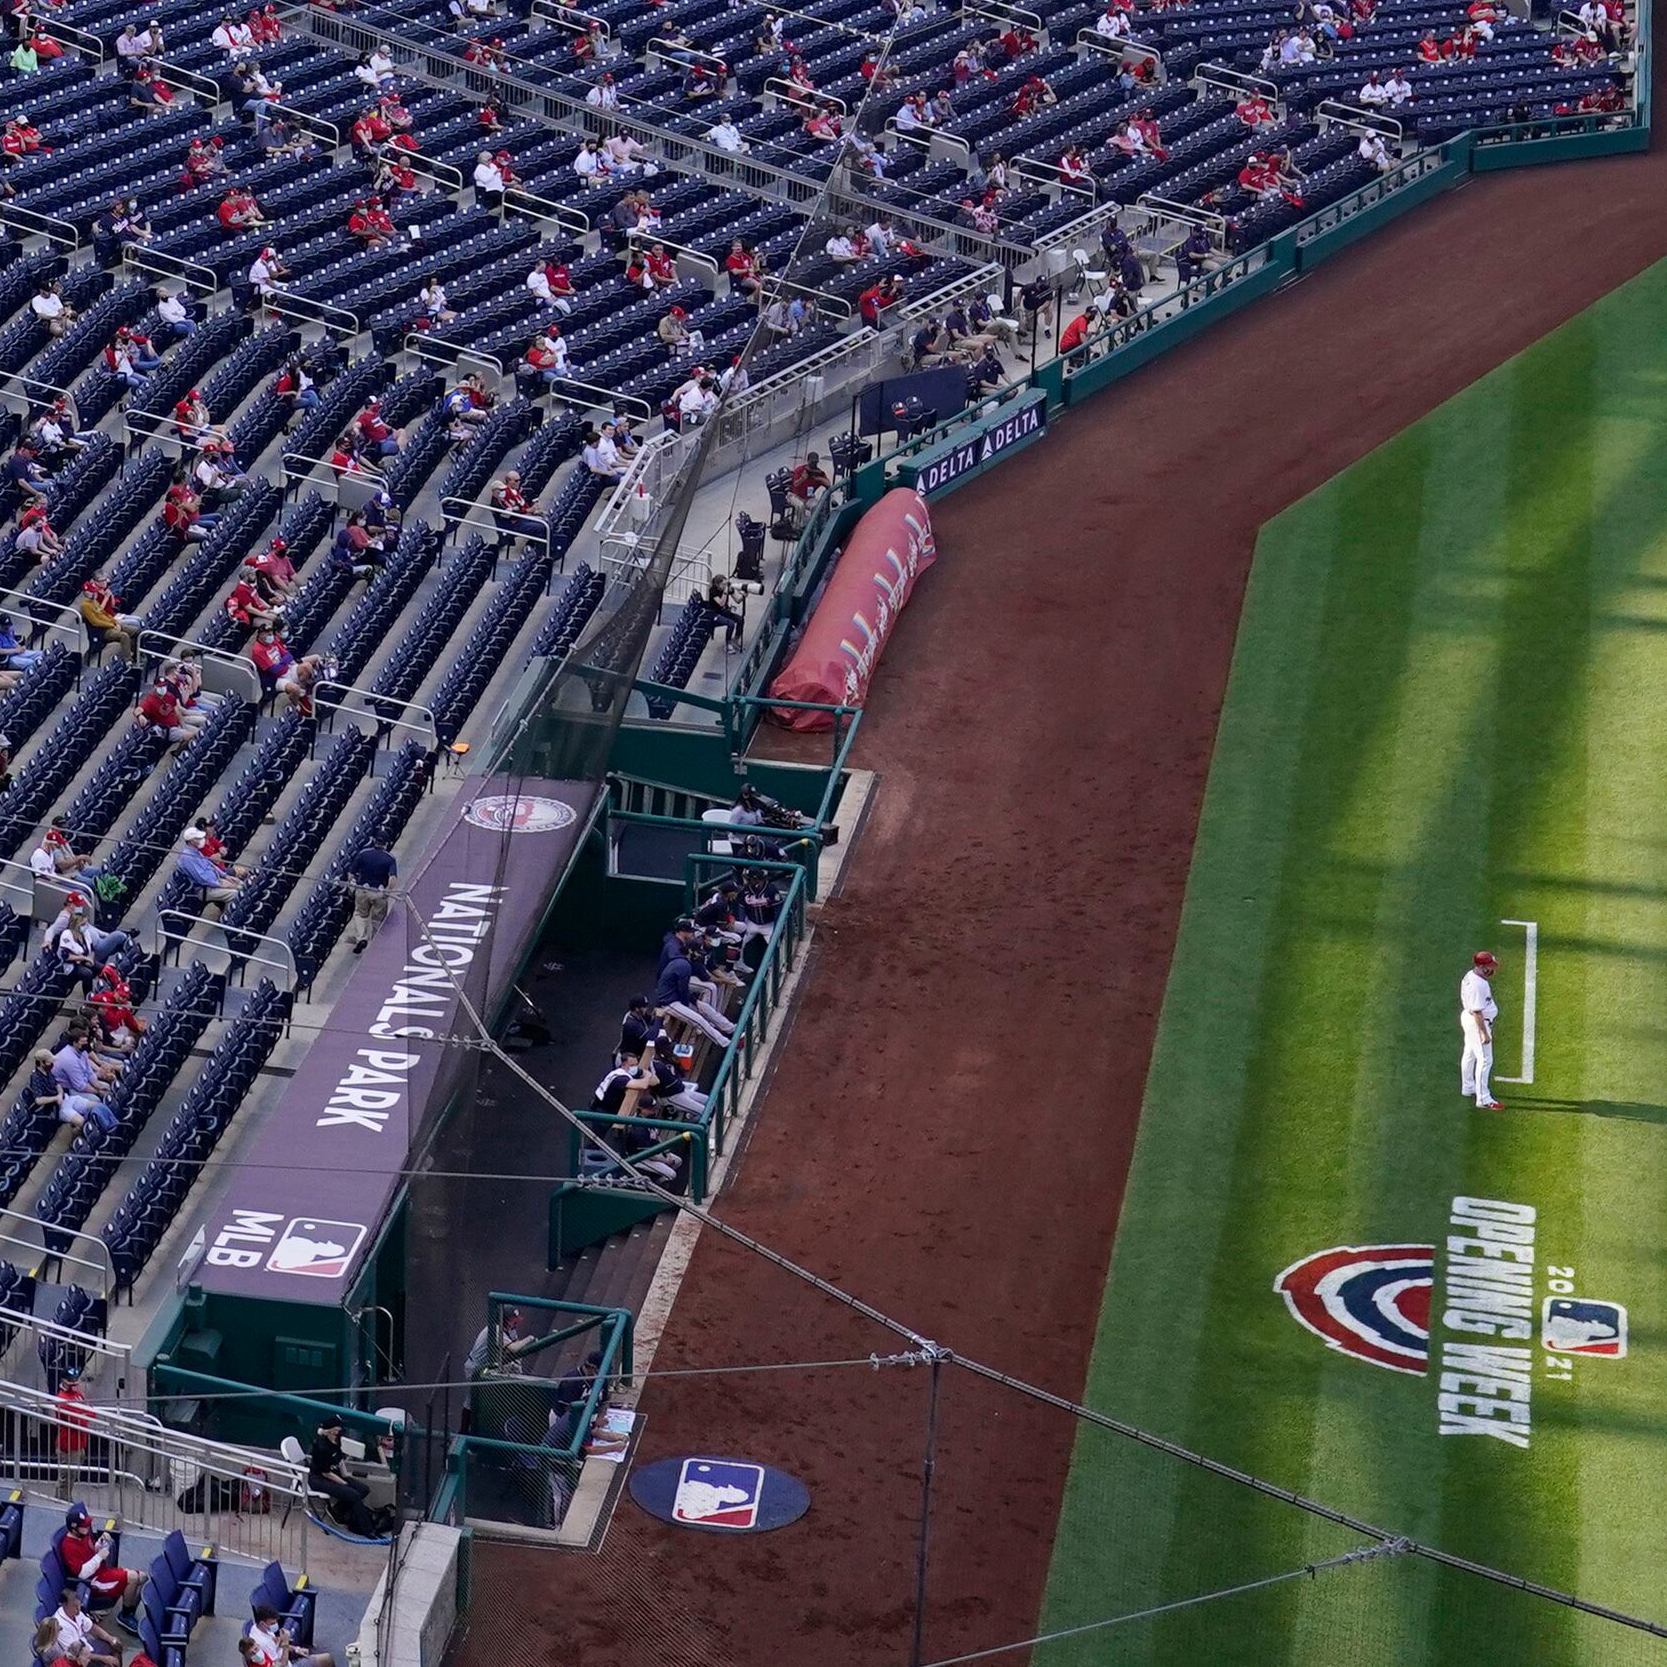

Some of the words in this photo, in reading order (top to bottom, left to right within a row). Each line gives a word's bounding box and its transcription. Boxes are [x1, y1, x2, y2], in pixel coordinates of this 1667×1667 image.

[996, 409, 1038, 450] DELTA
[929, 447, 974, 488] DELTA
[368, 882, 510, 1040] NATIONALS
[316, 1049, 420, 1133] PARK
[206, 1209, 284, 1268] MLB
[1442, 1196, 1536, 1339] OPENING
[1547, 1266, 1574, 1293] 20
[1438, 1342, 1531, 1448] WEEK
[1546, 1356, 1572, 1380] 21
